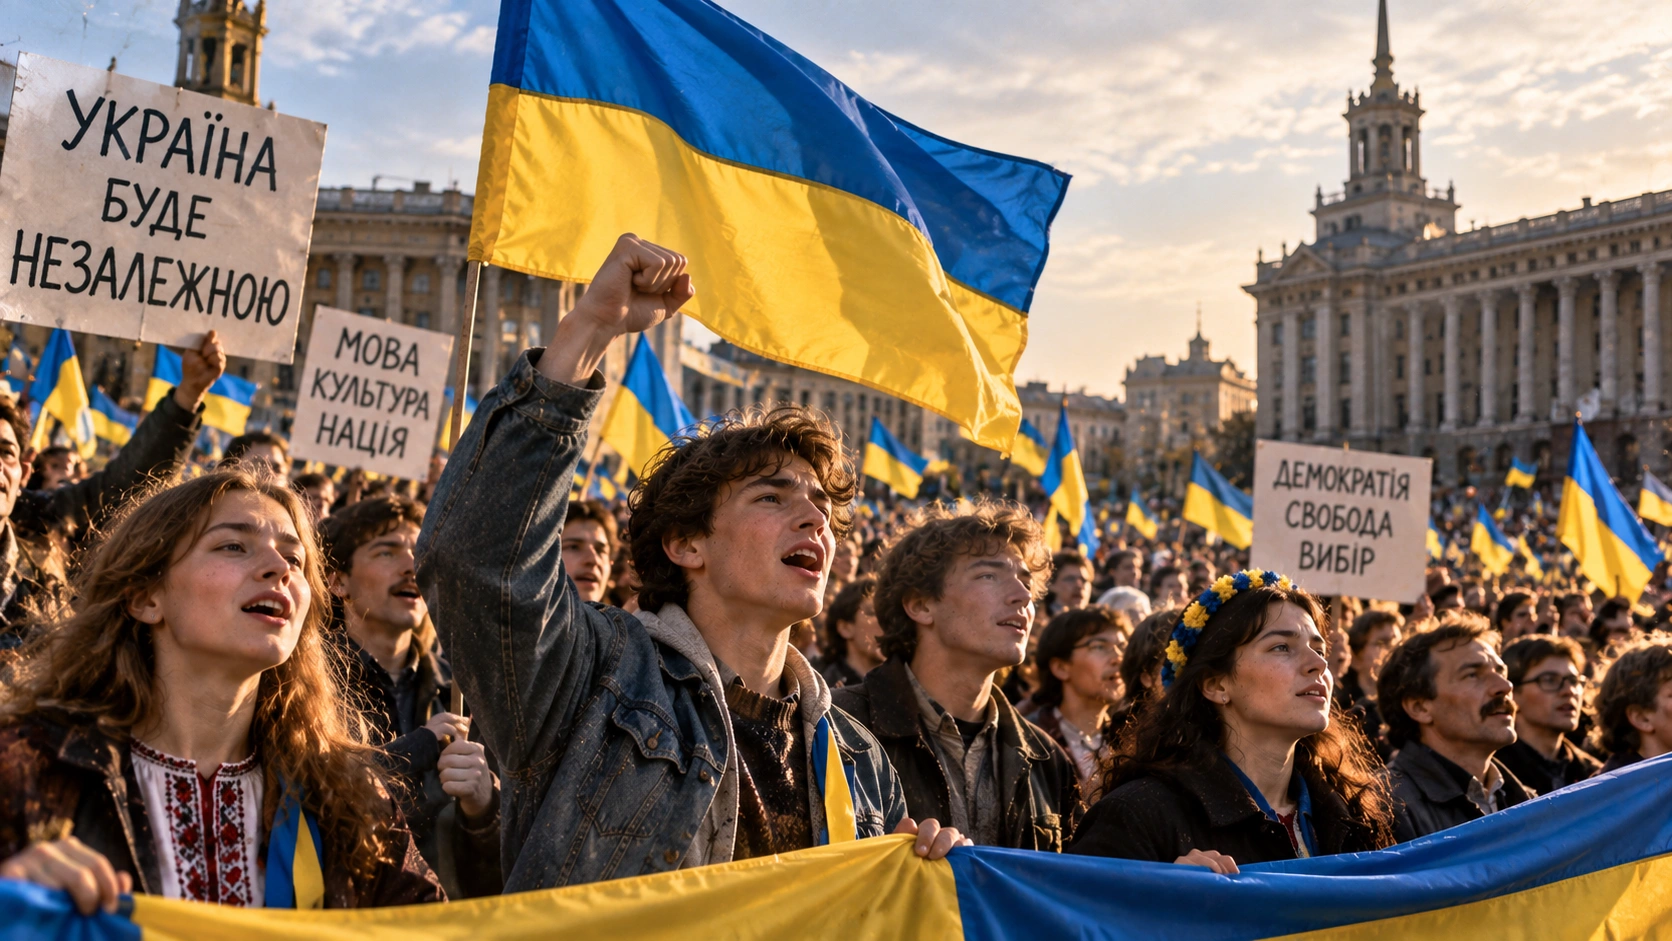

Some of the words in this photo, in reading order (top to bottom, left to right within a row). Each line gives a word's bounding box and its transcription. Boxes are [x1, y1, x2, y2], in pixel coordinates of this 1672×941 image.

[61, 88, 277, 192] УКРАЇНА
[101, 177, 213, 241] БУДЕ
[10, 228, 290, 326] НЕЗАЛЕЖНОЮ
[334, 326, 420, 377] МОВА
[310, 367, 430, 421] КУЛЬТУРА
[315, 411, 409, 459] НАЦІЯ
[1273, 459, 1411, 501] ДЕМОКРАТІЯ
[1285, 499, 1393, 540] СВОБОДА
[1298, 540, 1376, 576] ВИБІР
